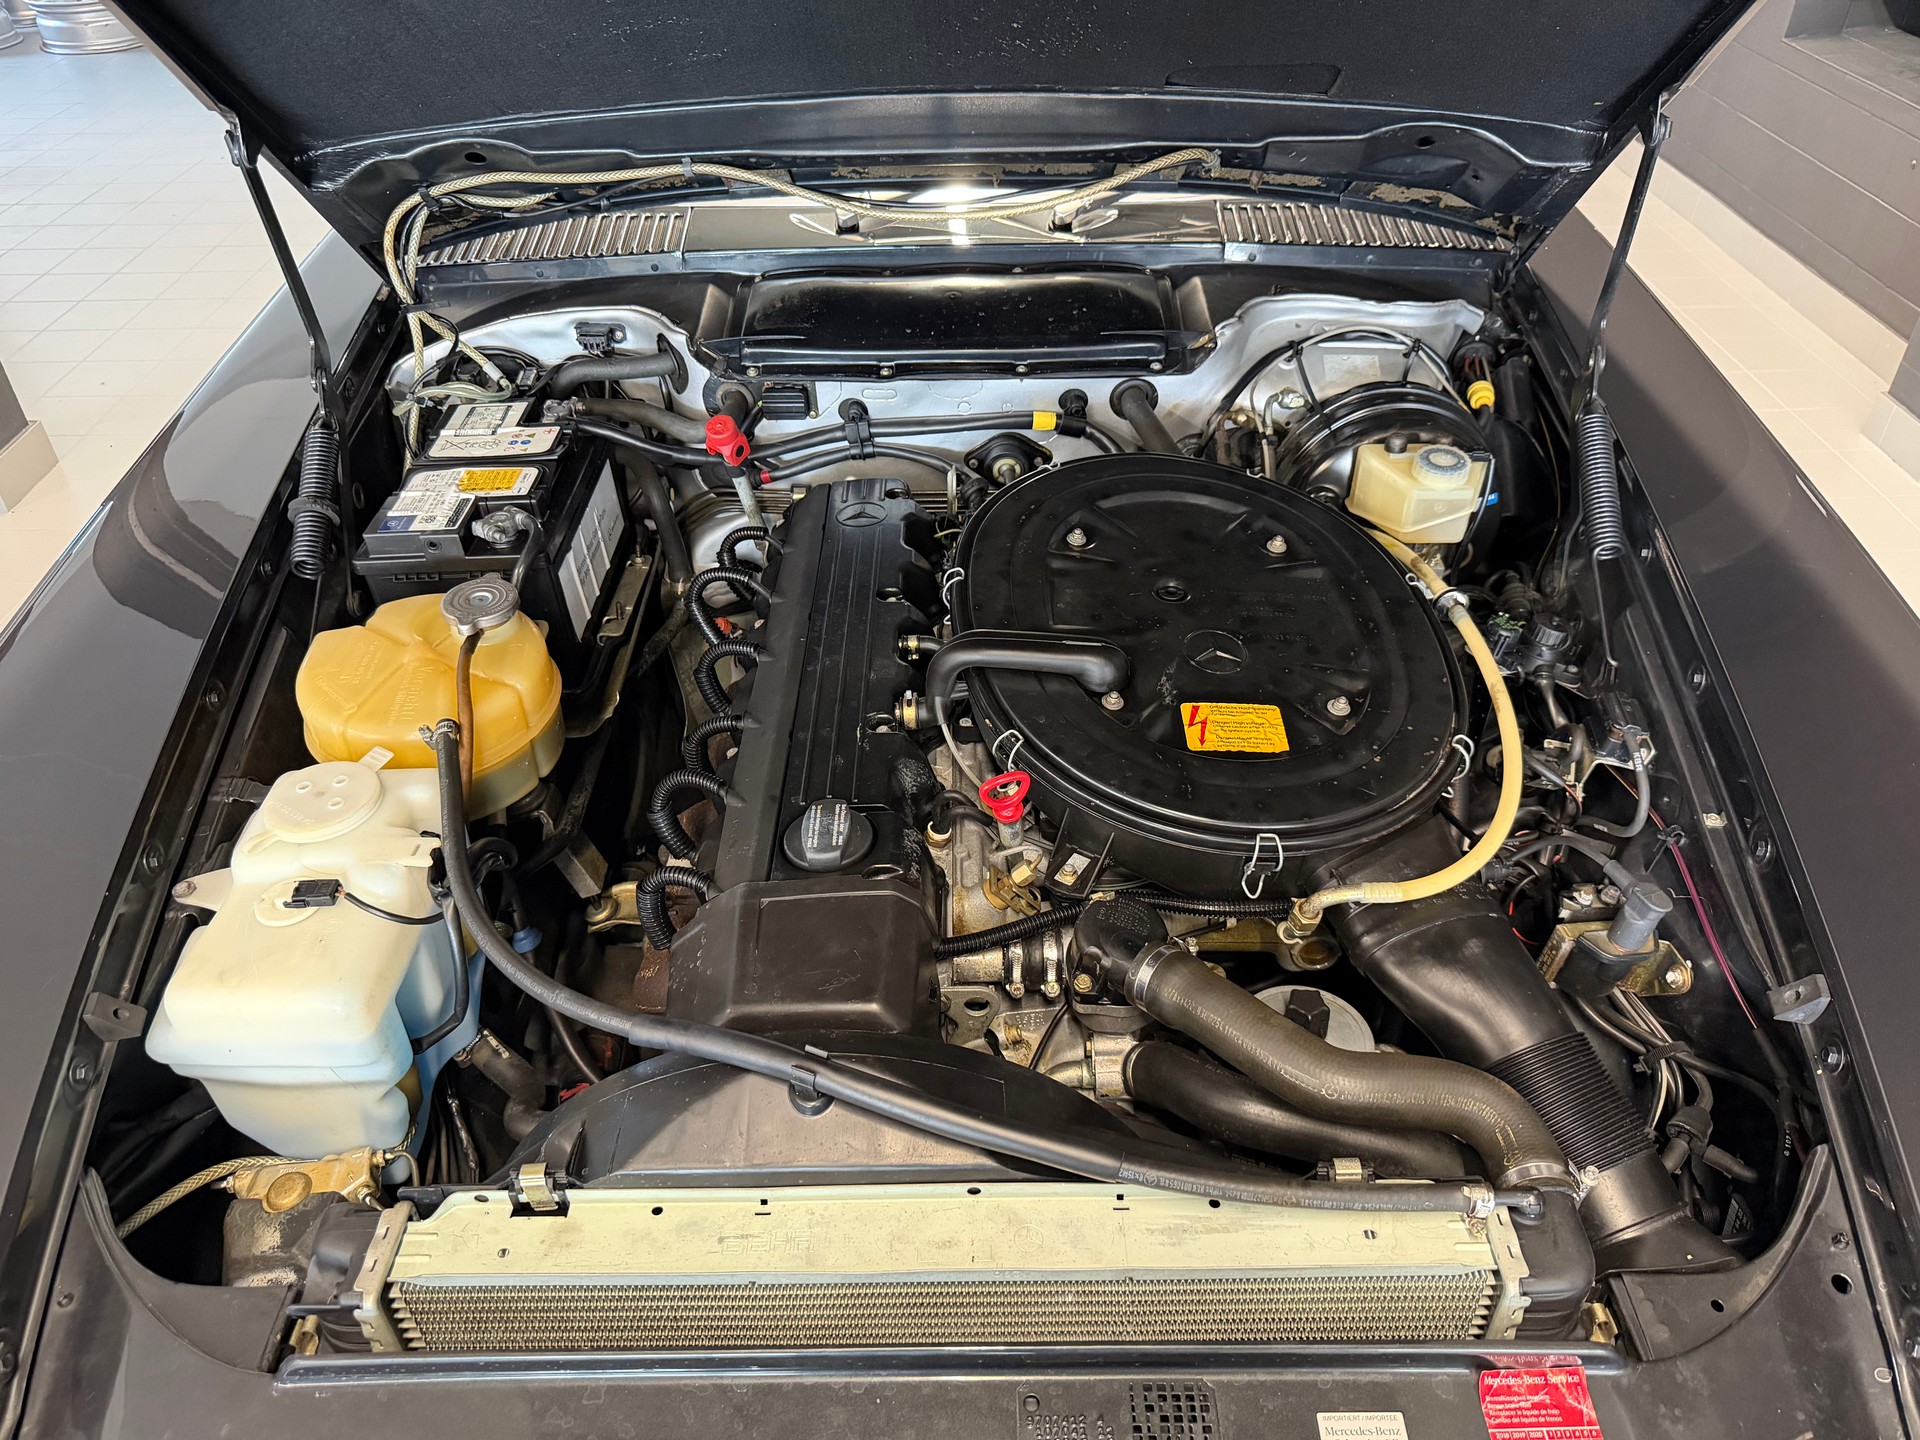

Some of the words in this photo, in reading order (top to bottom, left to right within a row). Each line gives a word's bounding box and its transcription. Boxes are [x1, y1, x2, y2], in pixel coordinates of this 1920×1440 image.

[1484, 1374, 1545, 1385] Mercedes-Benz
[1547, 1373, 1580, 1384] Service
[1325, 1427, 1401, 1436] Mercedes-Benz
